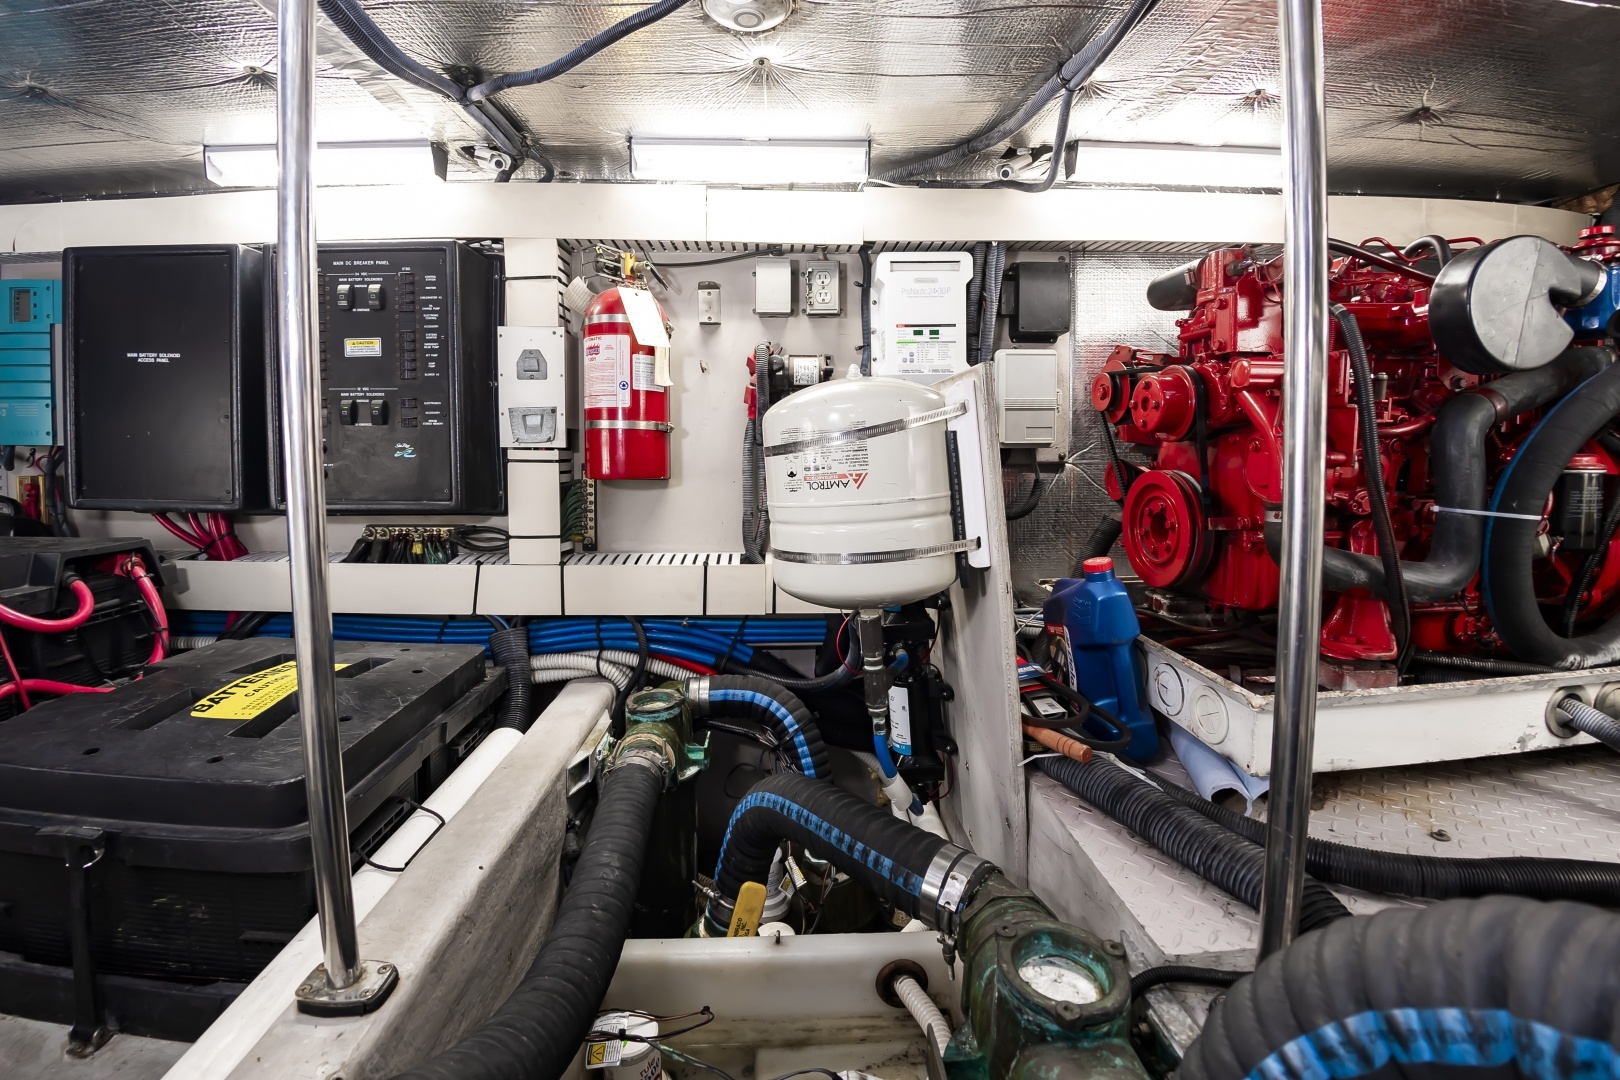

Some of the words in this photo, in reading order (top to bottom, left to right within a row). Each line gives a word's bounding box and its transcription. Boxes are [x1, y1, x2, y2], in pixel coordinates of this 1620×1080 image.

[807, 480, 850, 490] AMTROL
[244, 674, 291, 698] CAUTION
[640, 1056, 656, 1078] rule
